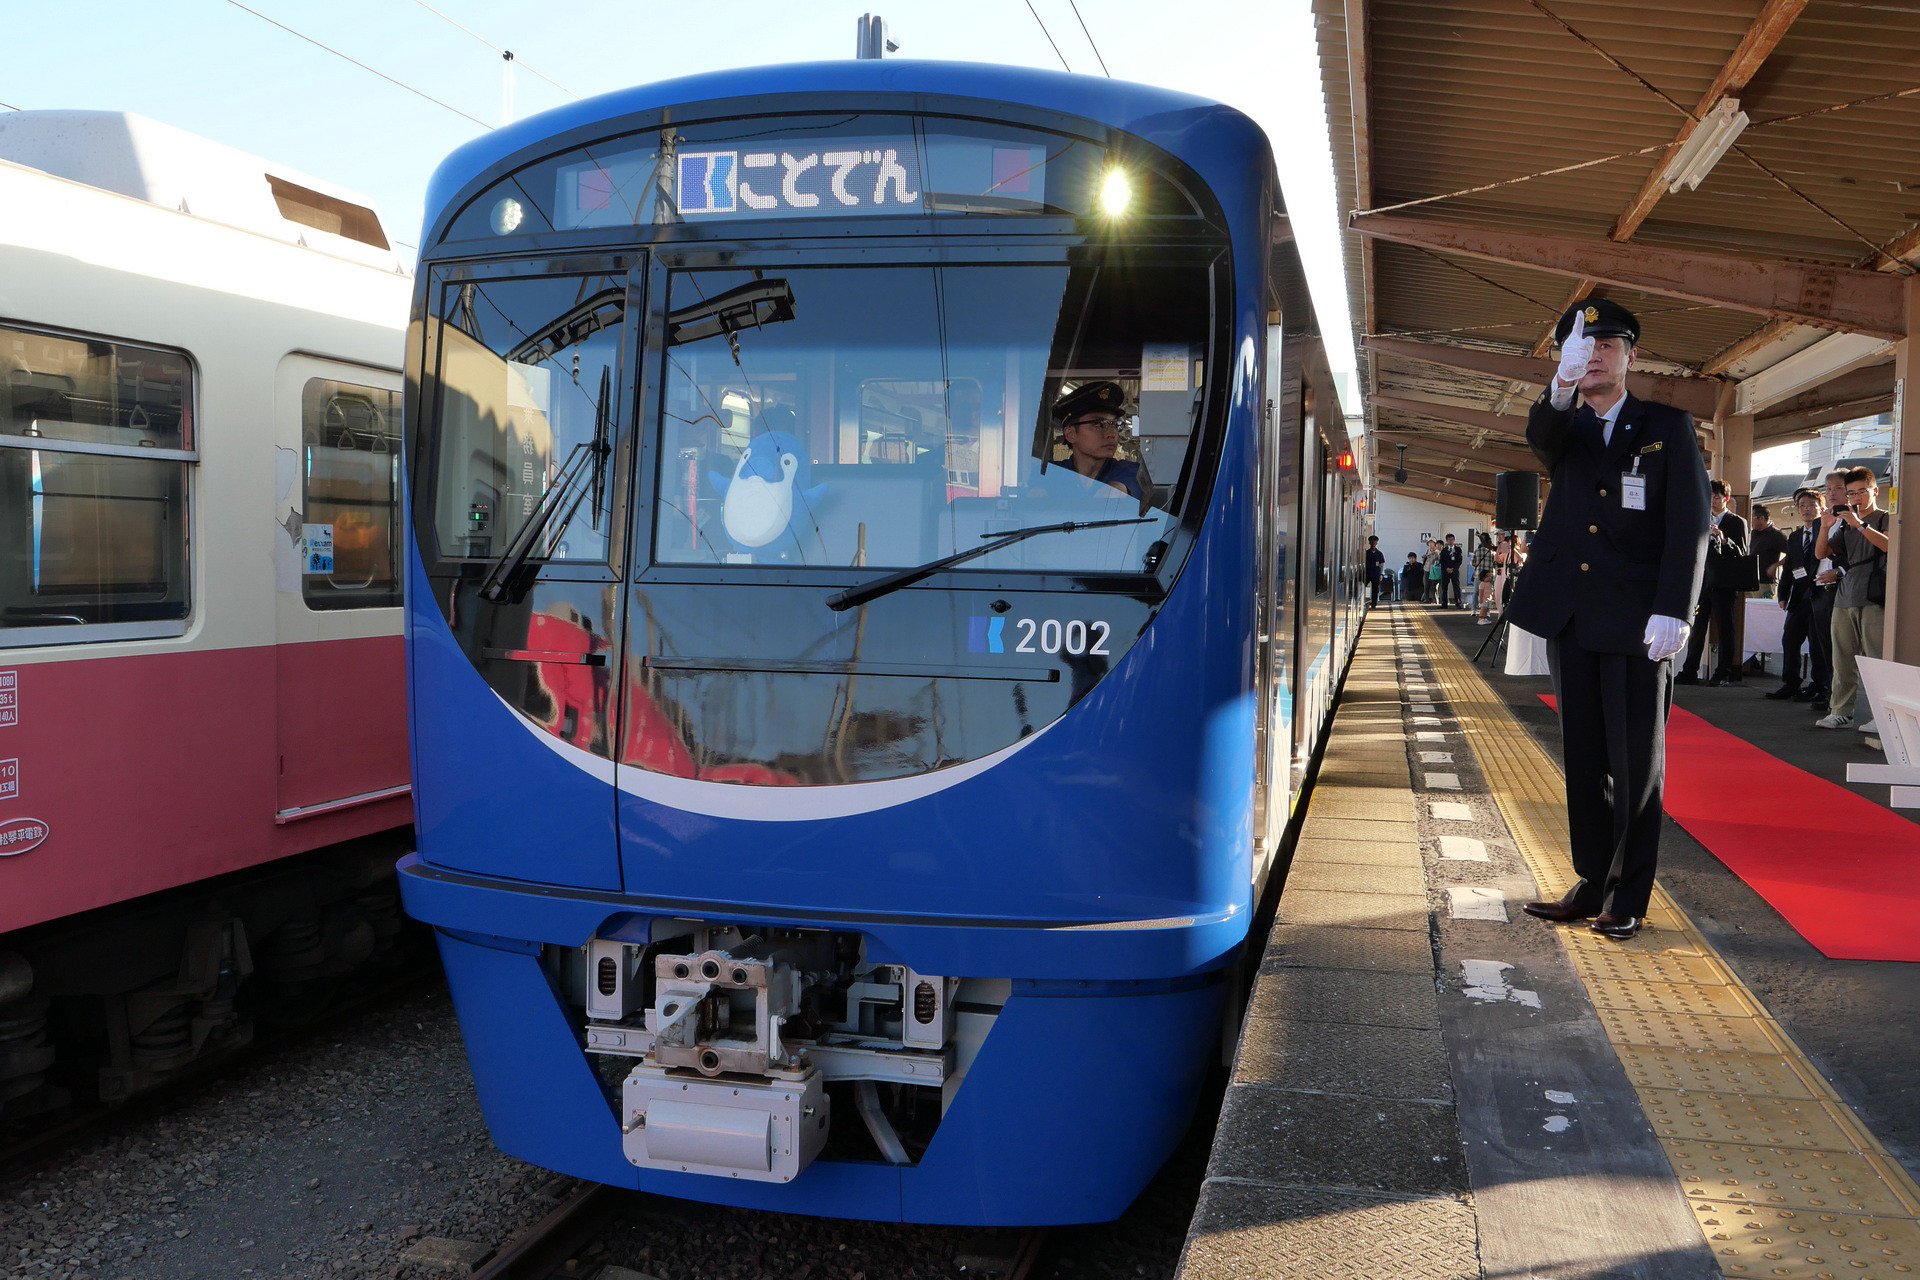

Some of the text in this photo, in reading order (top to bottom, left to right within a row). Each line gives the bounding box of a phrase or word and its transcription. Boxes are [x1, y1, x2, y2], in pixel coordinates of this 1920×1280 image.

[739, 149, 918, 209] ことでん
[1015, 618, 1111, 656] 2002
